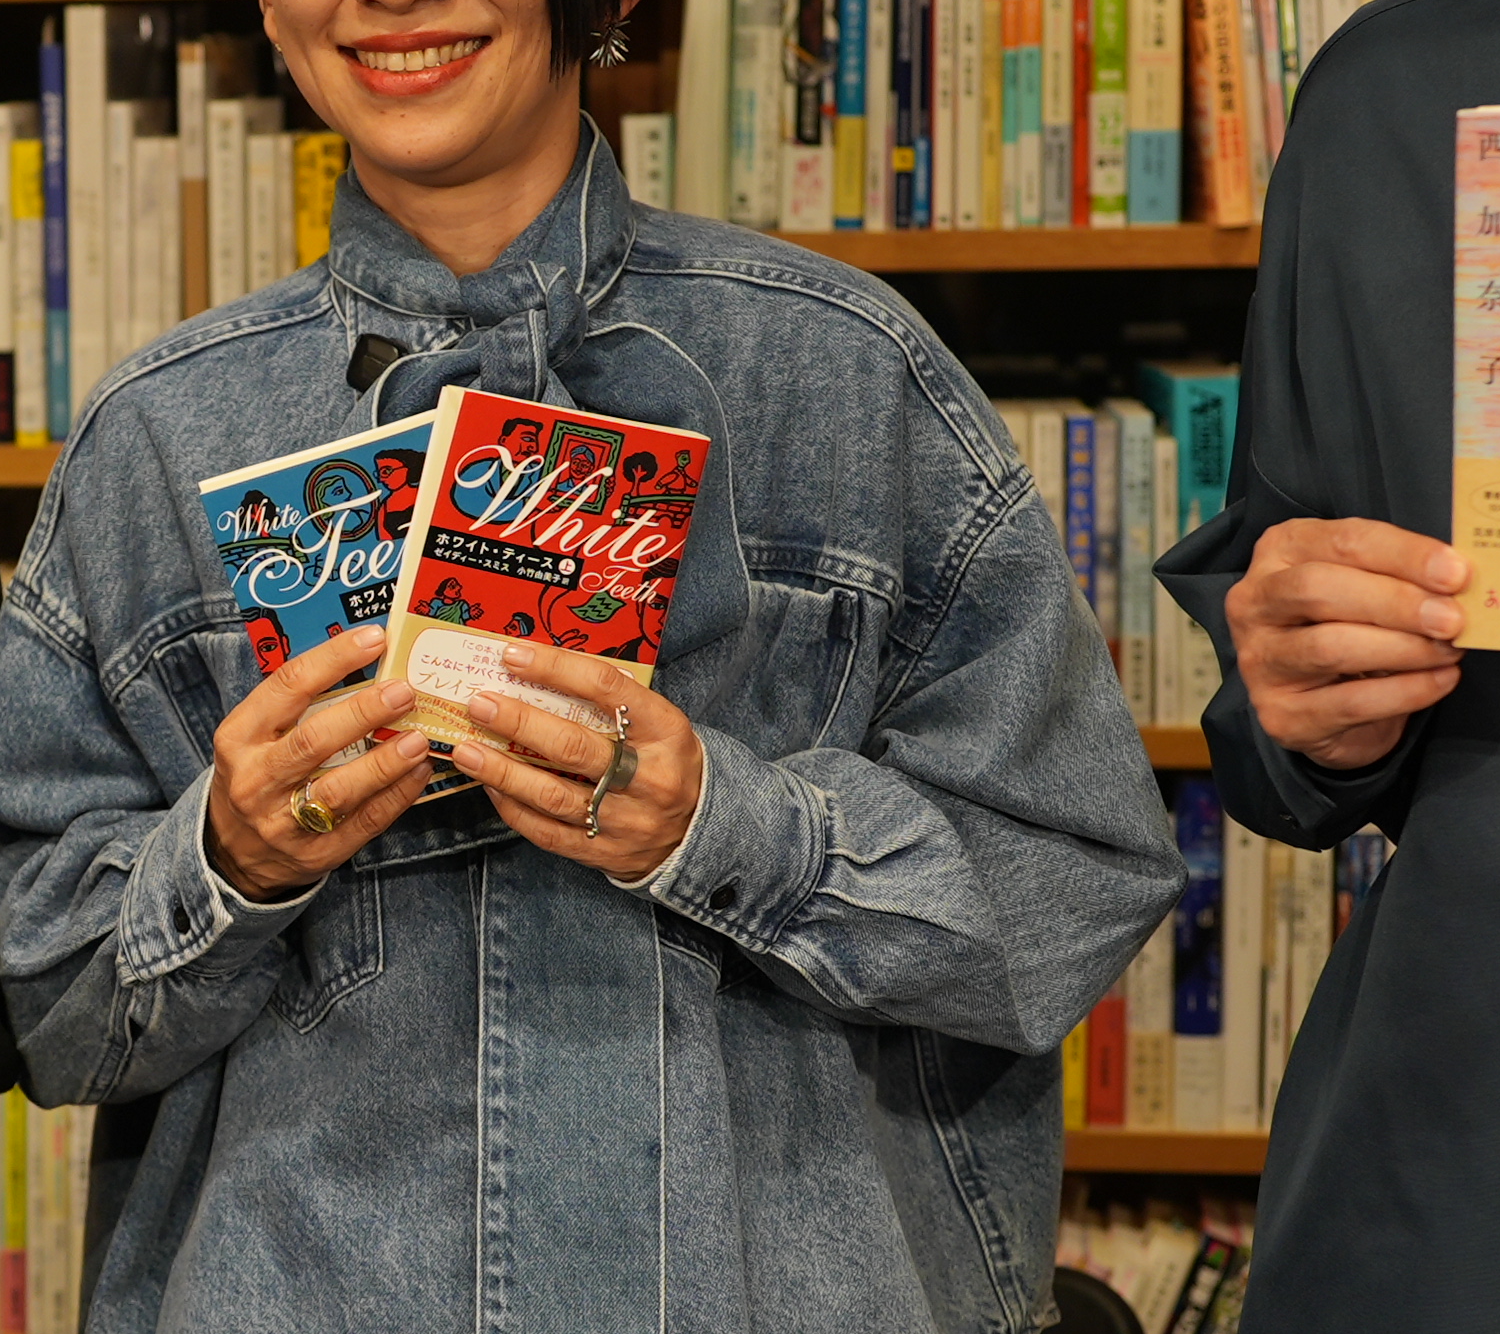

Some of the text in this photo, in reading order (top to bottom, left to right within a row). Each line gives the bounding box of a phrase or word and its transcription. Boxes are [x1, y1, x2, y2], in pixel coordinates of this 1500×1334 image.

[217, 498, 301, 545] White
[453, 443, 688, 568] White
[231, 490, 411, 609] Tee
[433, 547, 510, 573] ゼイディー・スミス
[435, 532, 554, 570] ホワイト・ティース
[578, 563, 659, 605] Teeth
